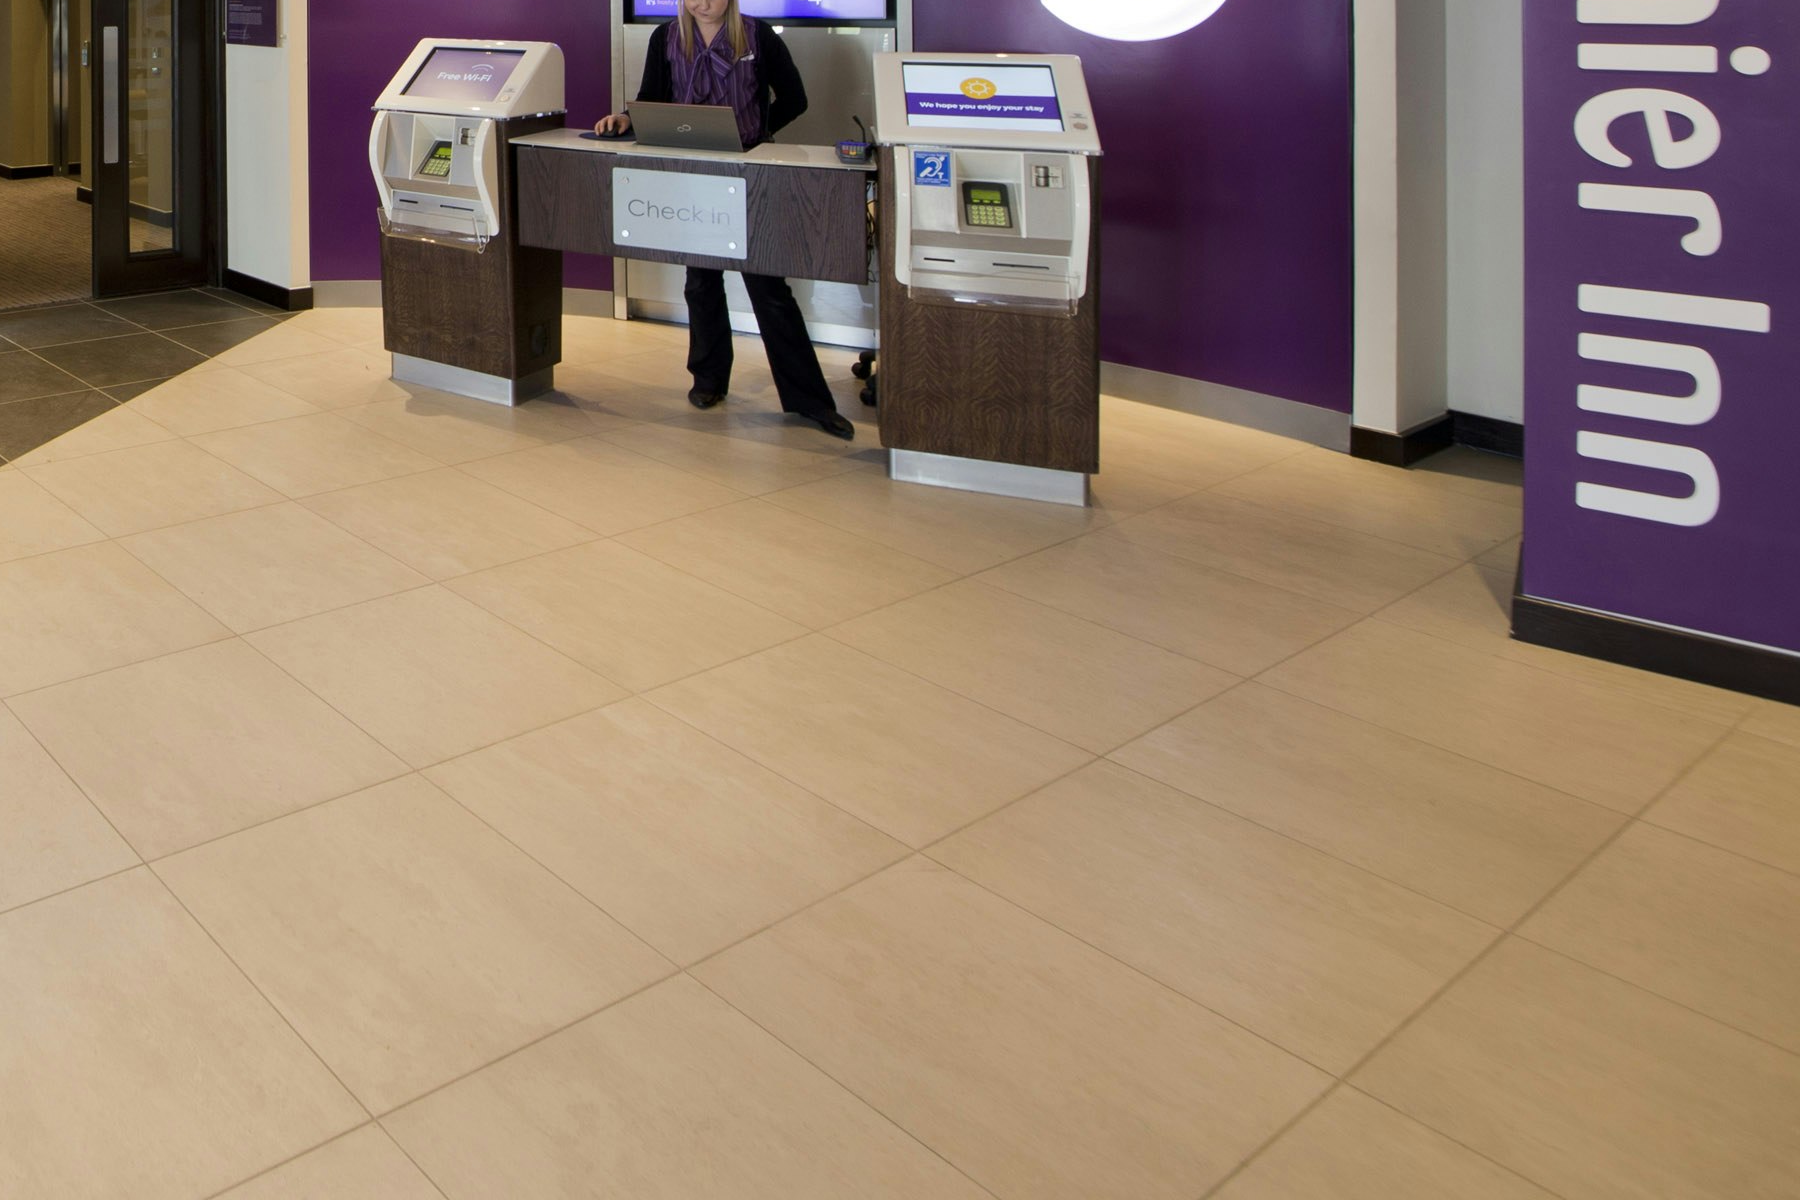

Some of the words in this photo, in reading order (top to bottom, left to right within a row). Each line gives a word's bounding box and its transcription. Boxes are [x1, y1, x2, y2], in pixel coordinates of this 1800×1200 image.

[437, 71, 461, 81] Free
[919, 101, 934, 109] We
[936, 101, 958, 110] hope
[959, 103, 976, 111] you
[977, 103, 1002, 112] enjoy
[1003, 104, 1024, 112] your
[1025, 104, 1045, 113] stay
[627, 199, 703, 223] Check
[1576, 283, 1771, 527] Inn
